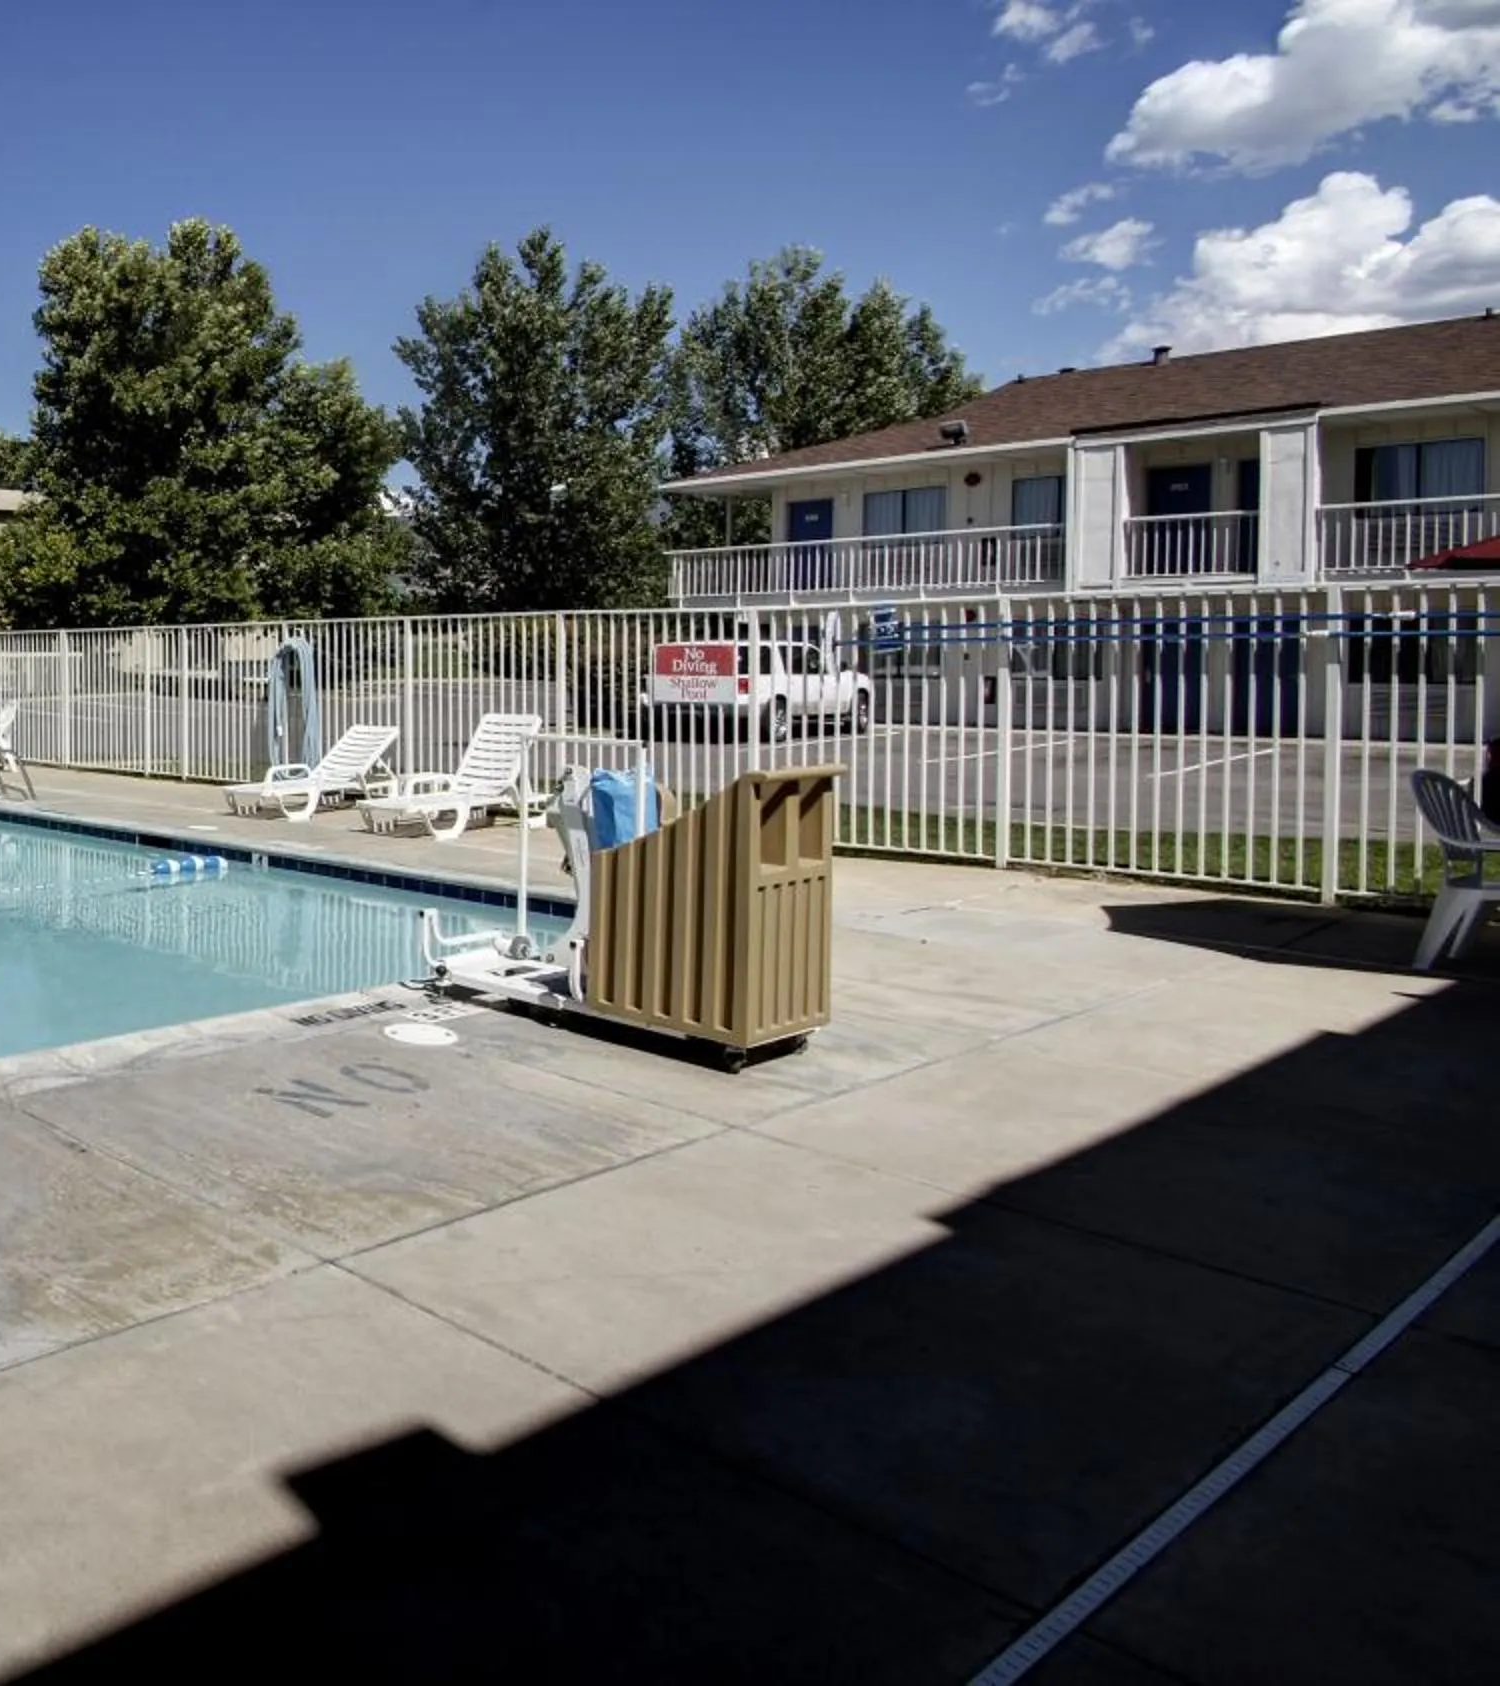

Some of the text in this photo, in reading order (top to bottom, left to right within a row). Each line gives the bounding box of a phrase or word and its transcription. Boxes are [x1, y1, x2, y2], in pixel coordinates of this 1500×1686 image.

[684, 647, 705, 660] No
[672, 659, 718, 675] Diving
[669, 676, 717, 690] Shallow
[681, 687, 708, 700] Pool
[254, 1062, 431, 1119] NO
